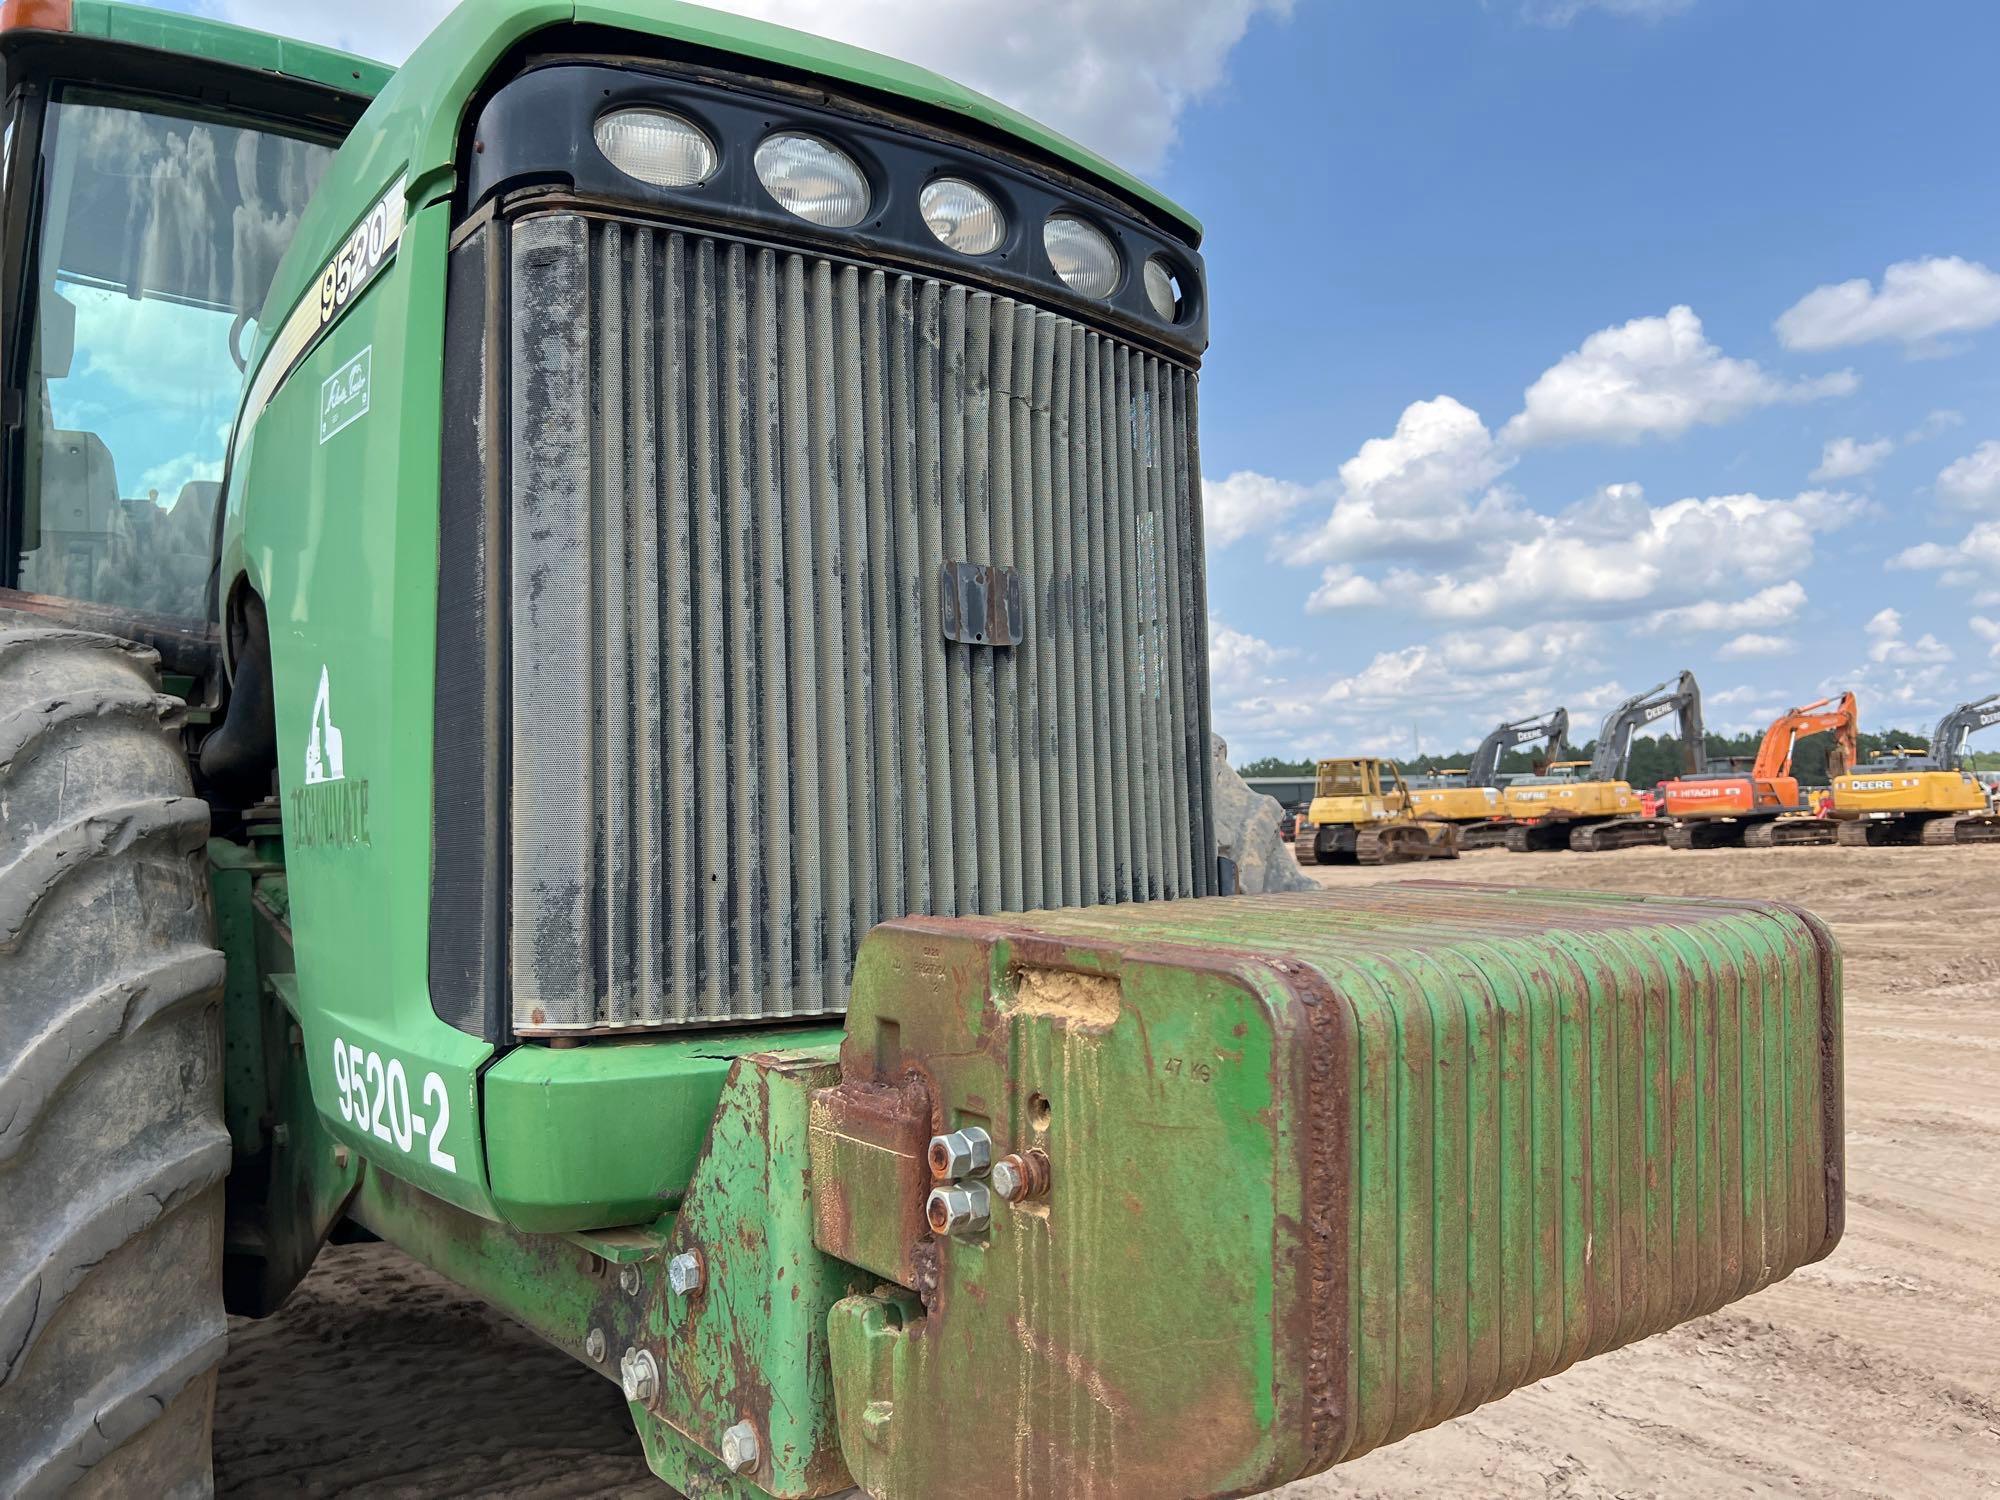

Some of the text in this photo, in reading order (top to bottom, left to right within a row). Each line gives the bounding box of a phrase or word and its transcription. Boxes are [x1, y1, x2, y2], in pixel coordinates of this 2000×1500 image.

[321, 200, 387, 323] 9520
[1644, 701, 1673, 721] DEERE
[1517, 728, 1542, 742] DEERE
[1681, 788, 1719, 799] HITACHI
[1851, 780, 1893, 790] DEERE
[333, 1037, 457, 1174] 9520-2
